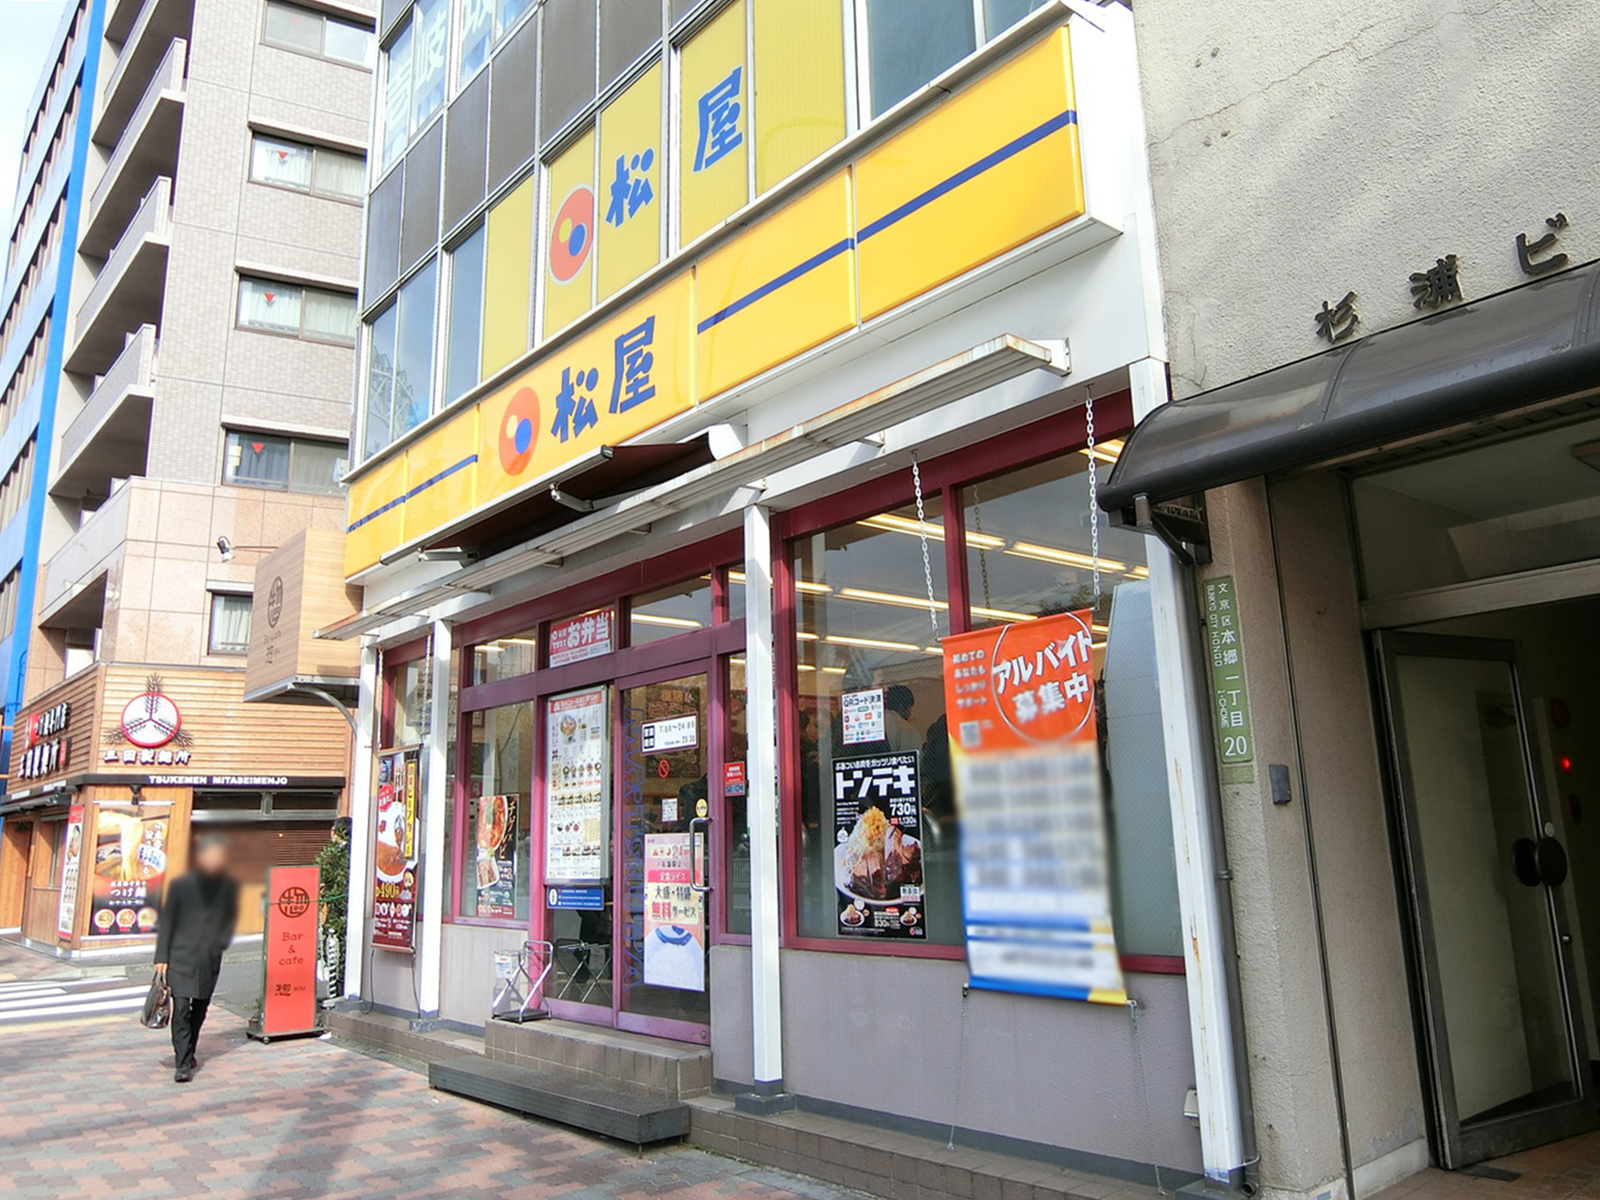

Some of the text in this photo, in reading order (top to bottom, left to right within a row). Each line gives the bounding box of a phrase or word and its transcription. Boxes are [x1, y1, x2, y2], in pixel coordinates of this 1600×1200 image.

[605, 65, 743, 229] 松屋
[1315, 213, 1569, 344] 杉浦ビ
[551, 315, 656, 444] 松屋
[1206, 584, 1218, 611] BUNKYO
[567, 612, 609, 648] お弁当
[1209, 613, 1219, 628] CITY
[1211, 630, 1223, 667] HONGO
[992, 630, 1092, 695] アルバイト
[1012, 671, 1090, 725] 募集中
[1223, 735, 1247, 757] 20
[149, 776, 288, 785] TSUKEMEN MITASEIMENJO
[835, 765, 916, 800] トンテキ
[889, 802, 917, 817] 730円
[655, 885, 692, 900] 大盛・特盛
[651, 901, 696, 920] 無料サービス
[282, 931, 303, 941] Bar
[278, 956, 304, 966] cafe
[288, 944, 296, 954] &
